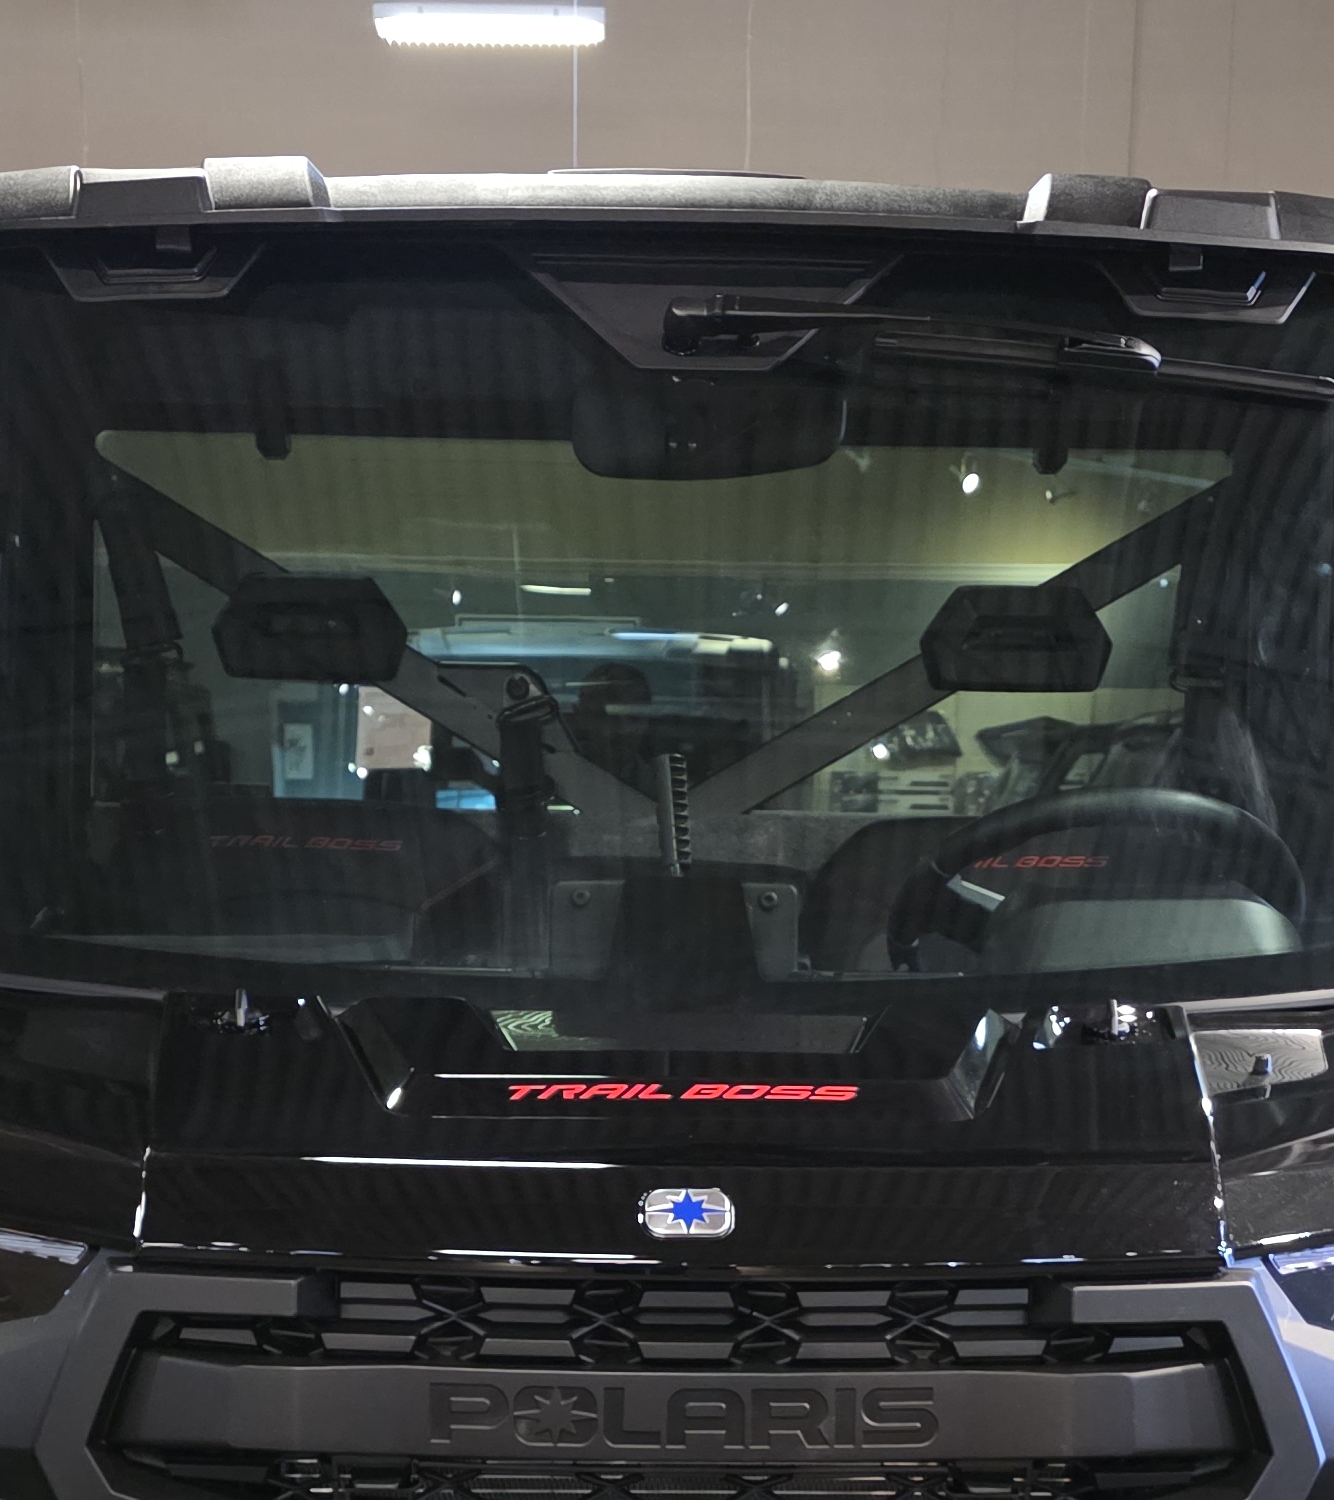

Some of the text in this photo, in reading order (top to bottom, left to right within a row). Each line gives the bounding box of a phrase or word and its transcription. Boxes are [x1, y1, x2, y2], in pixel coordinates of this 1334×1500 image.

[210, 835, 403, 851] TRAIL BOSS
[1014, 855, 1110, 869] BOSS
[508, 1083, 861, 1102] TRAIL BOSS
[429, 1382, 941, 1451] POLARIS
